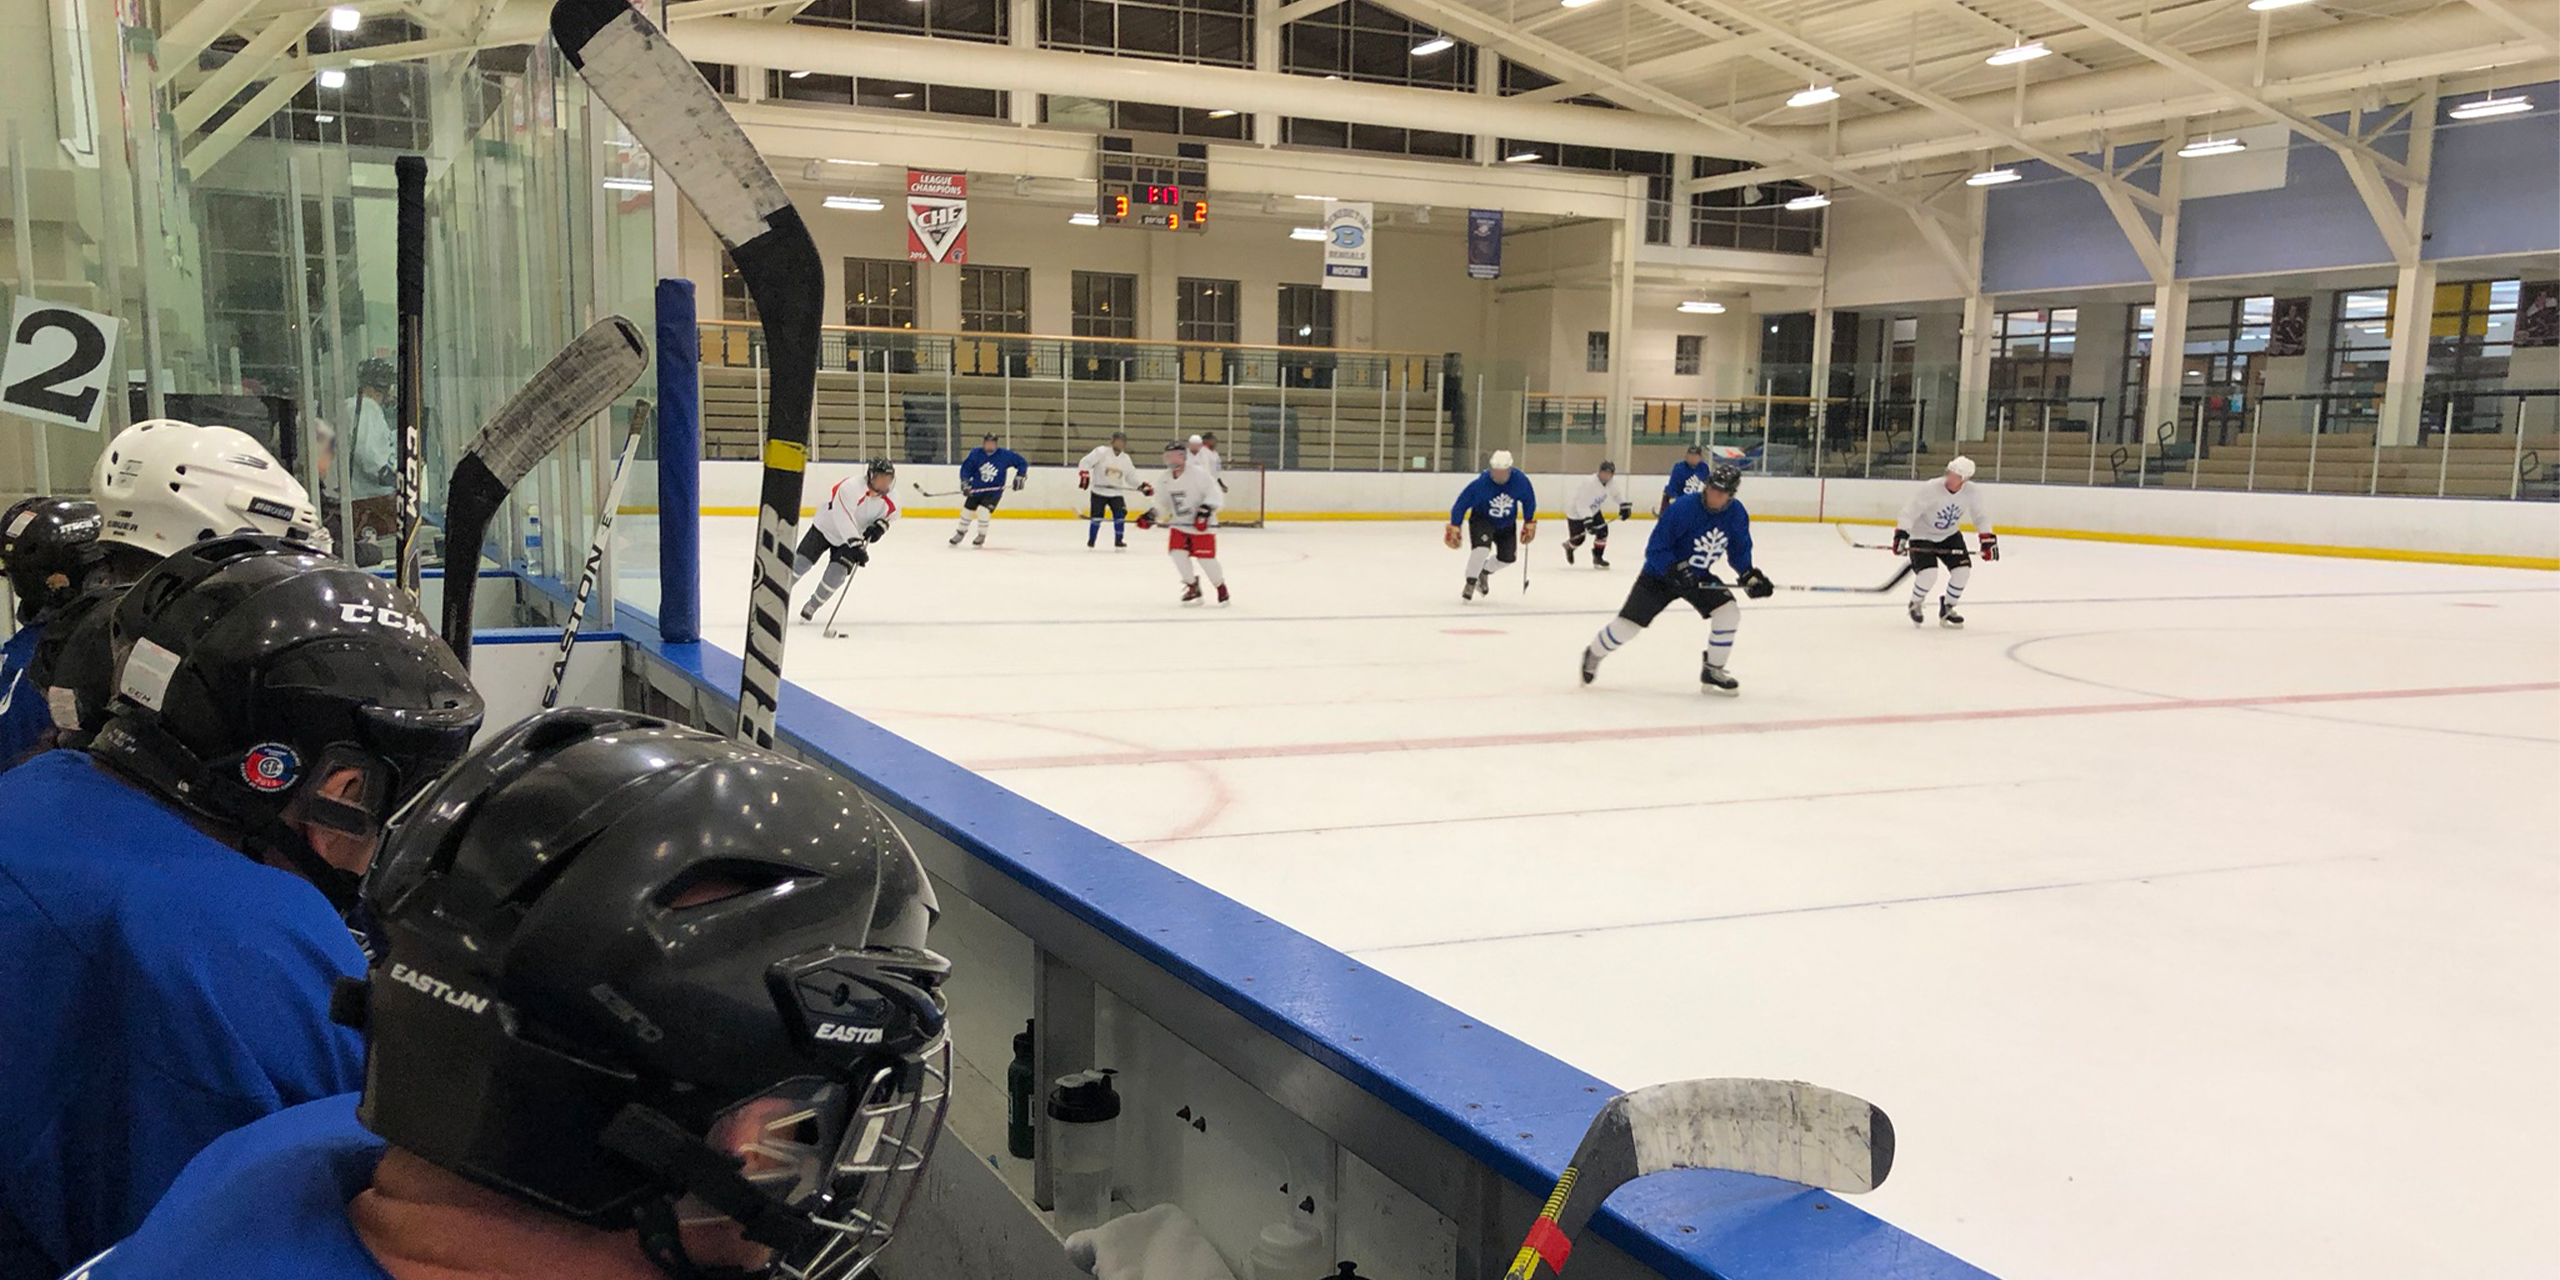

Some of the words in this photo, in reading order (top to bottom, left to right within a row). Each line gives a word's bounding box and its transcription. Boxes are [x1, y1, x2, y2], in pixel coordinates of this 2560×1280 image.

[910, 182, 962, 195] CHAMPIONS
[920, 174, 953, 186] LEAGUE
[916, 206, 964, 228] CHE
[1116, 195, 1128, 217] 3
[1194, 201, 1207, 222] 2
[1168, 213, 1178, 230] 3
[4, 309, 106, 423] 2
[406, 425, 420, 519] CCM
[1170, 490, 1193, 517] E
[339, 602, 427, 639] CCM
[541, 543, 604, 709] EASTON
[390, 963, 490, 1015] EASTON
[814, 1022, 885, 1044] EASTON
